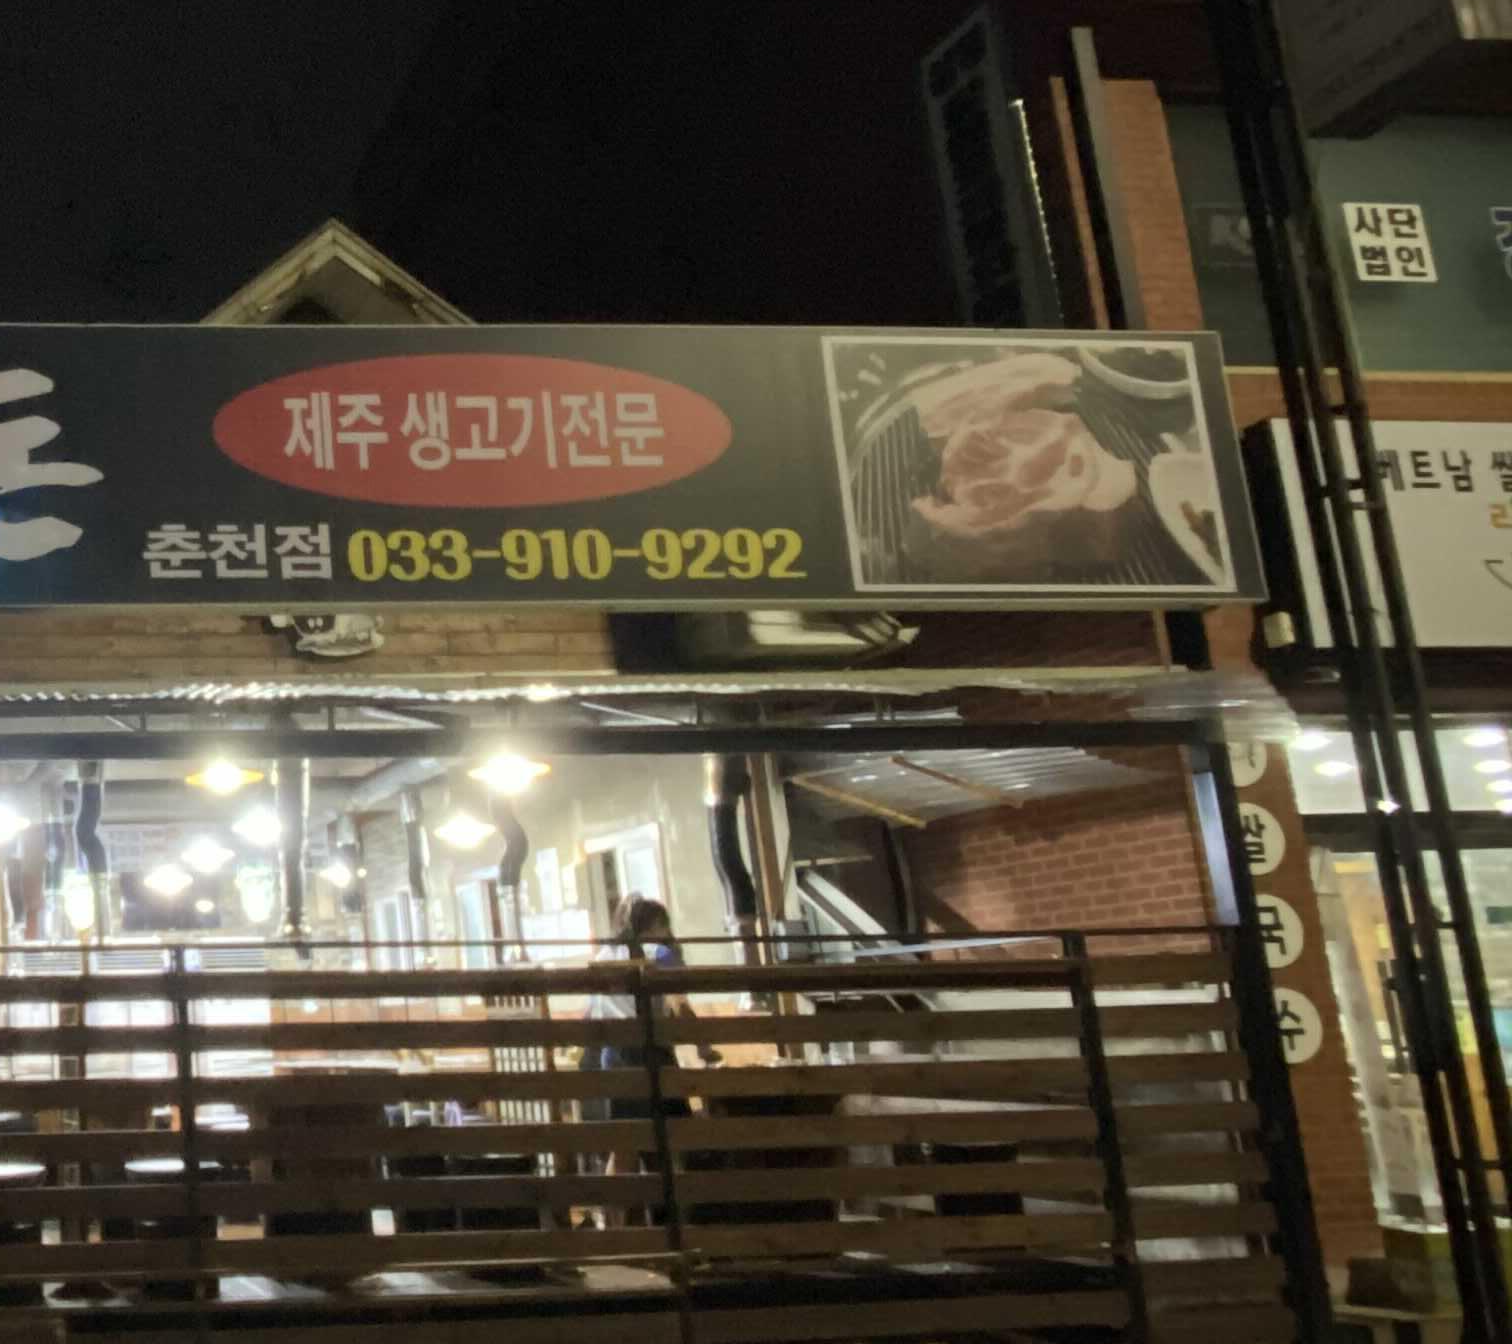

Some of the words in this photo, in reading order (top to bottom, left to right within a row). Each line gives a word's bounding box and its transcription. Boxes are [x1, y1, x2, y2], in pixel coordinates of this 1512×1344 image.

[1355, 207, 1419, 238] 사단
[1360, 246, 1428, 277] 법인
[284, 391, 388, 471] 제주
[400, 391, 665, 470] 생고기전문
[142, 523, 333, 580] 춘천점
[347, 527, 808, 582] 033-910-9292
